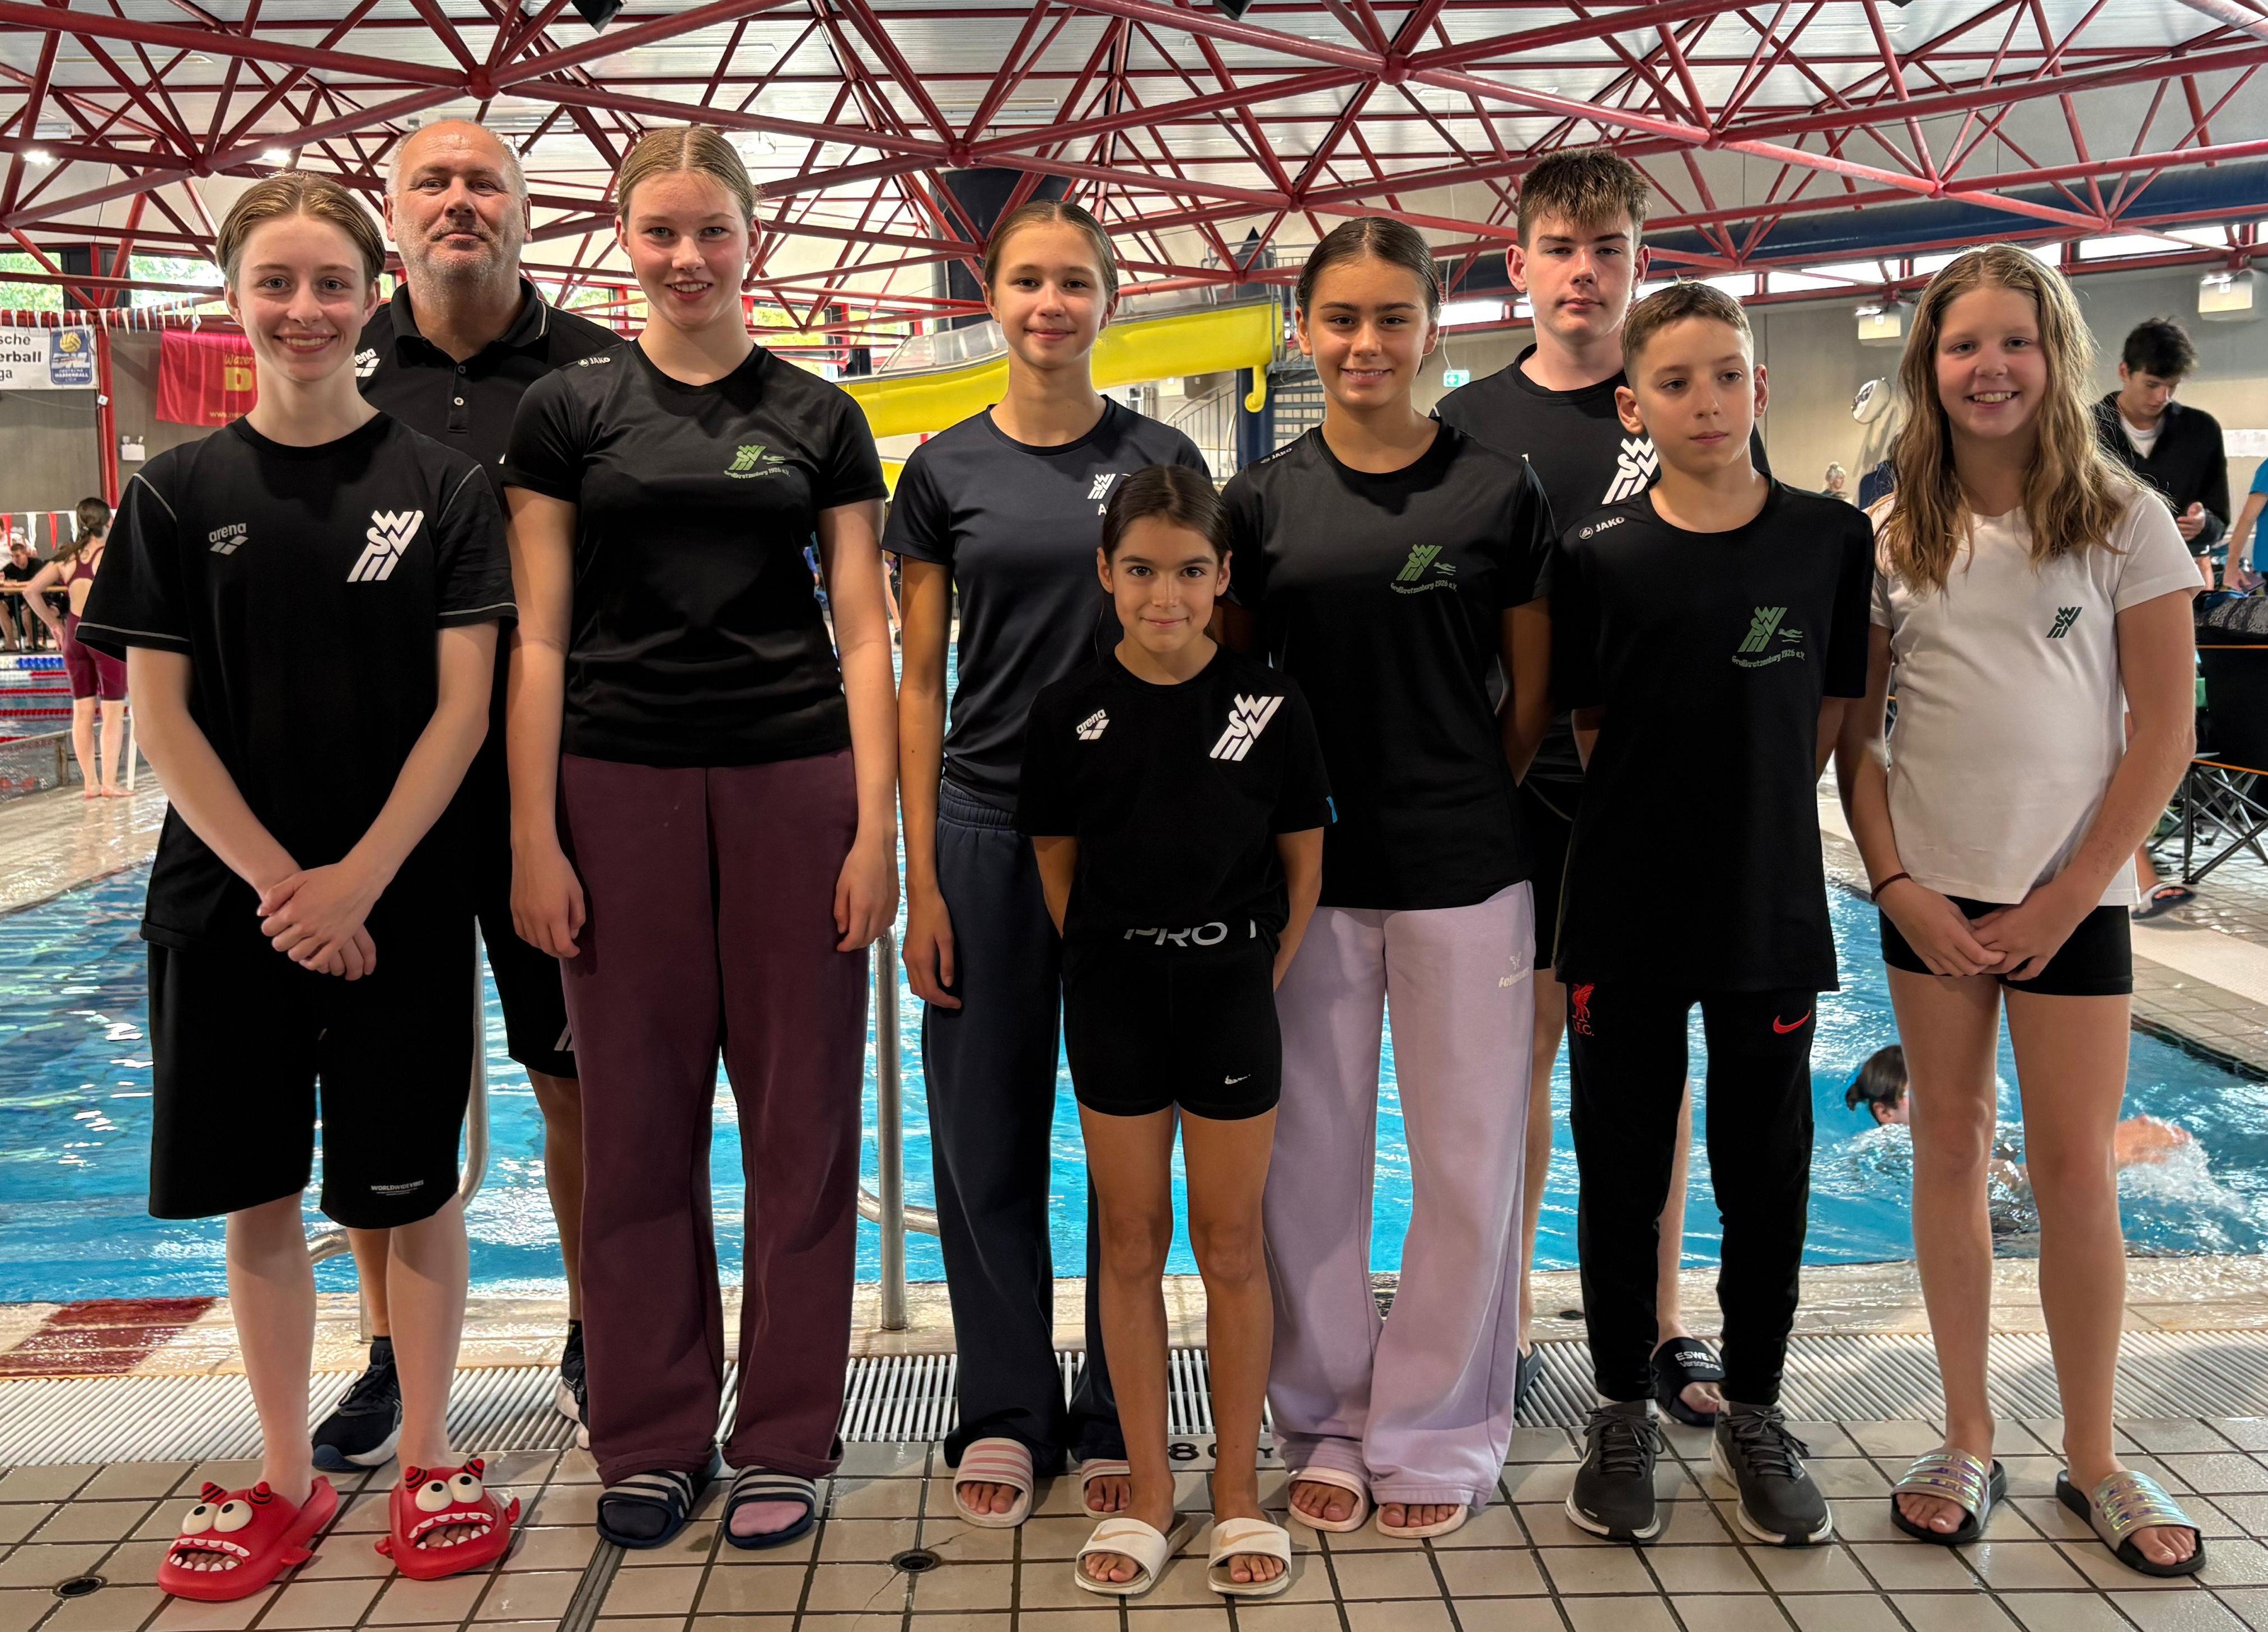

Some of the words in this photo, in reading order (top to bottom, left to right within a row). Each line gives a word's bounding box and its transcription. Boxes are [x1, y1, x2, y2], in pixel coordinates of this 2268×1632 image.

[209, 522, 247, 543] arena
[1596, 517, 1625, 532] JAKO
[1076, 709, 1107, 735] arena
[1675, 1351, 1709, 1361] ESWE
